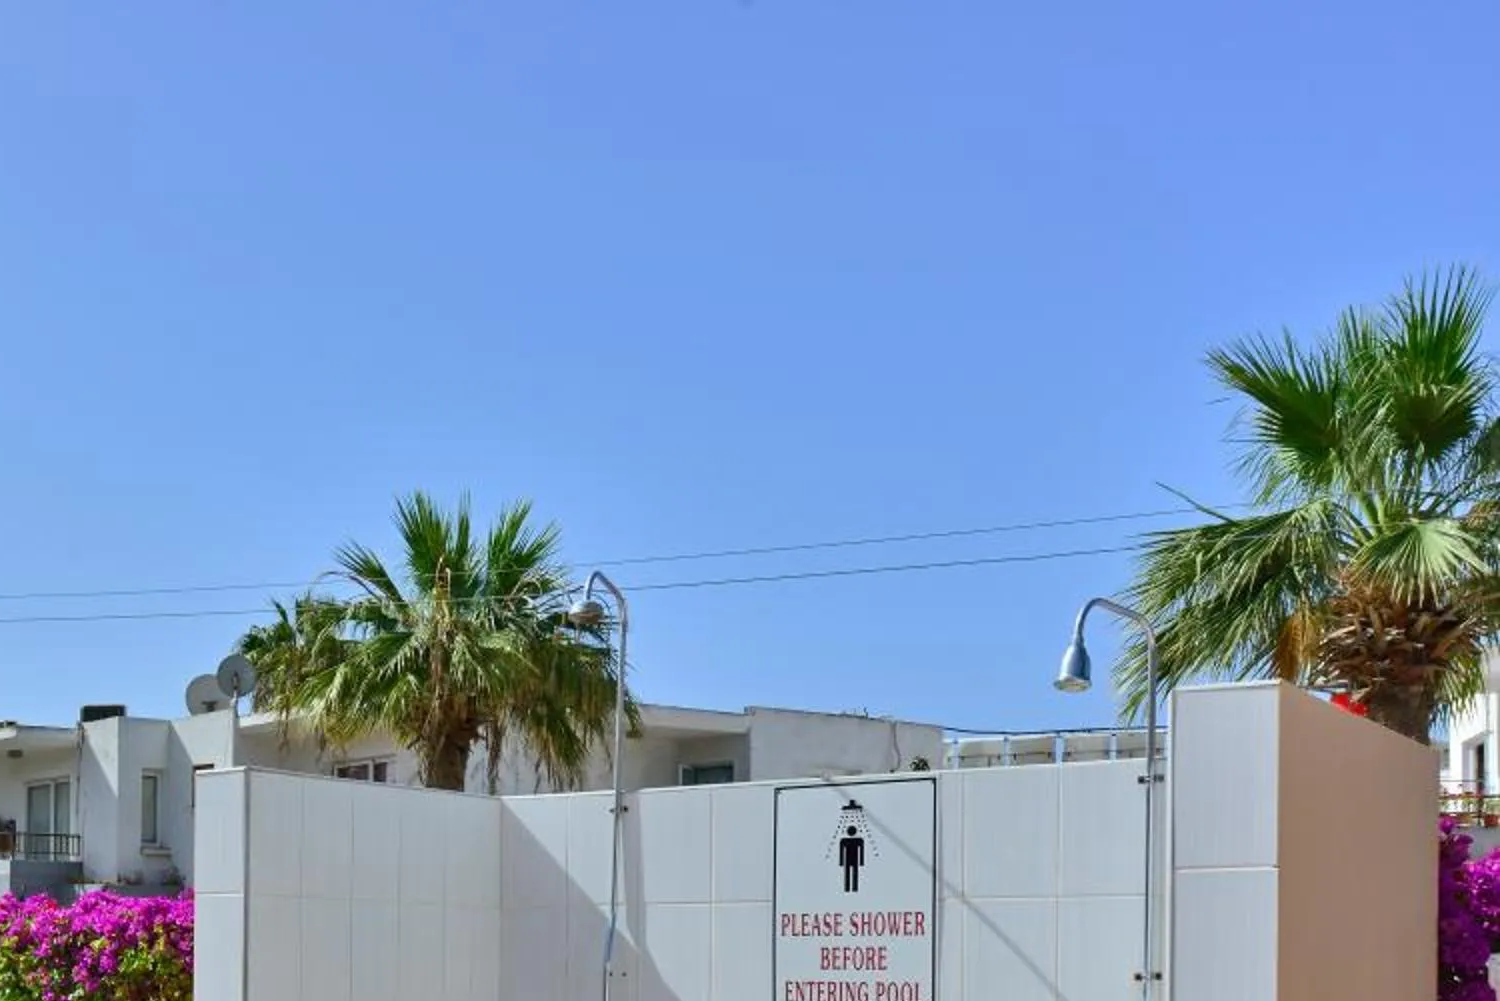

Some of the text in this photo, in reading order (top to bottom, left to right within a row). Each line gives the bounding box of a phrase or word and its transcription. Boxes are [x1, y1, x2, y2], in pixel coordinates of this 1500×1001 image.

[781, 911, 925, 937] PLEASE SHOWER
[820, 947, 887, 971] BEFORE
